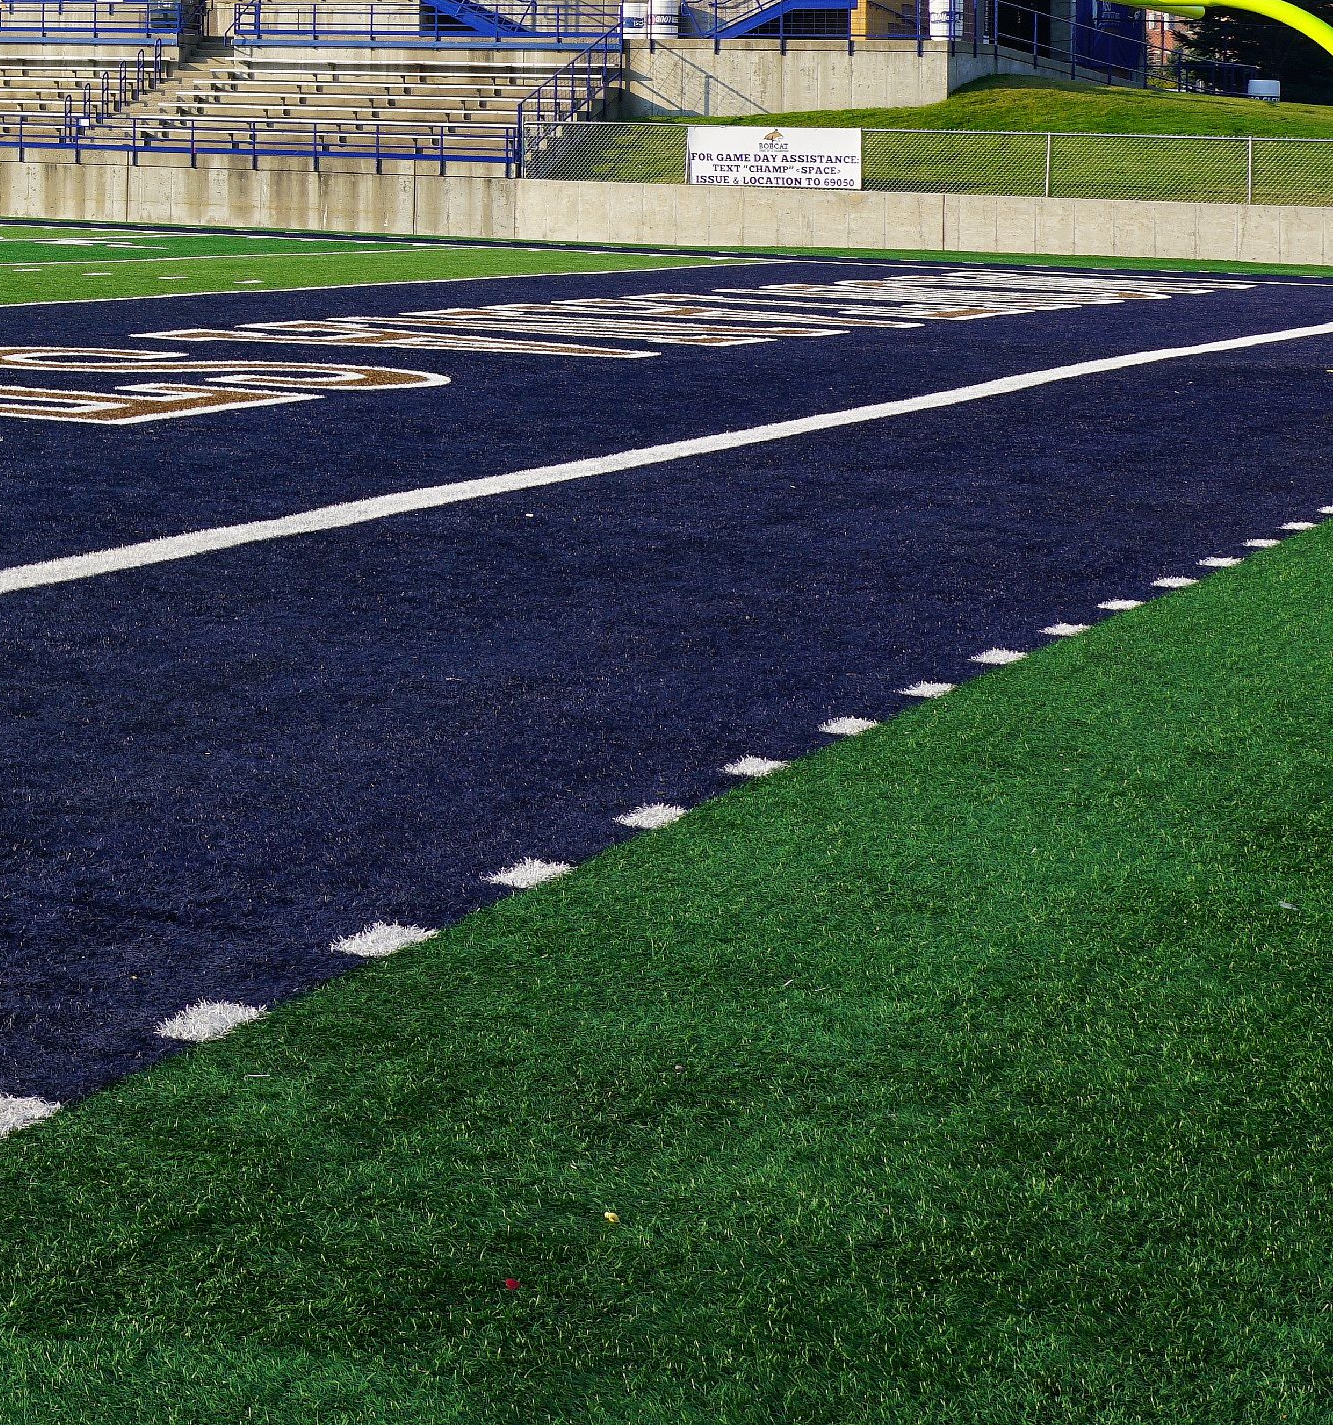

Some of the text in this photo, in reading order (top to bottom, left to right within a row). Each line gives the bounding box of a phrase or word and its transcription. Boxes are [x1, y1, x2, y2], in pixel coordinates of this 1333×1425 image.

[758, 142, 789, 150] BOBCAT
[690, 152, 860, 164] FOR GAME DAY ASSISTANCE:
[713, 164, 740, 172] TEXT
[695, 175, 855, 187] ISSUE & LOCATION TO 69050
